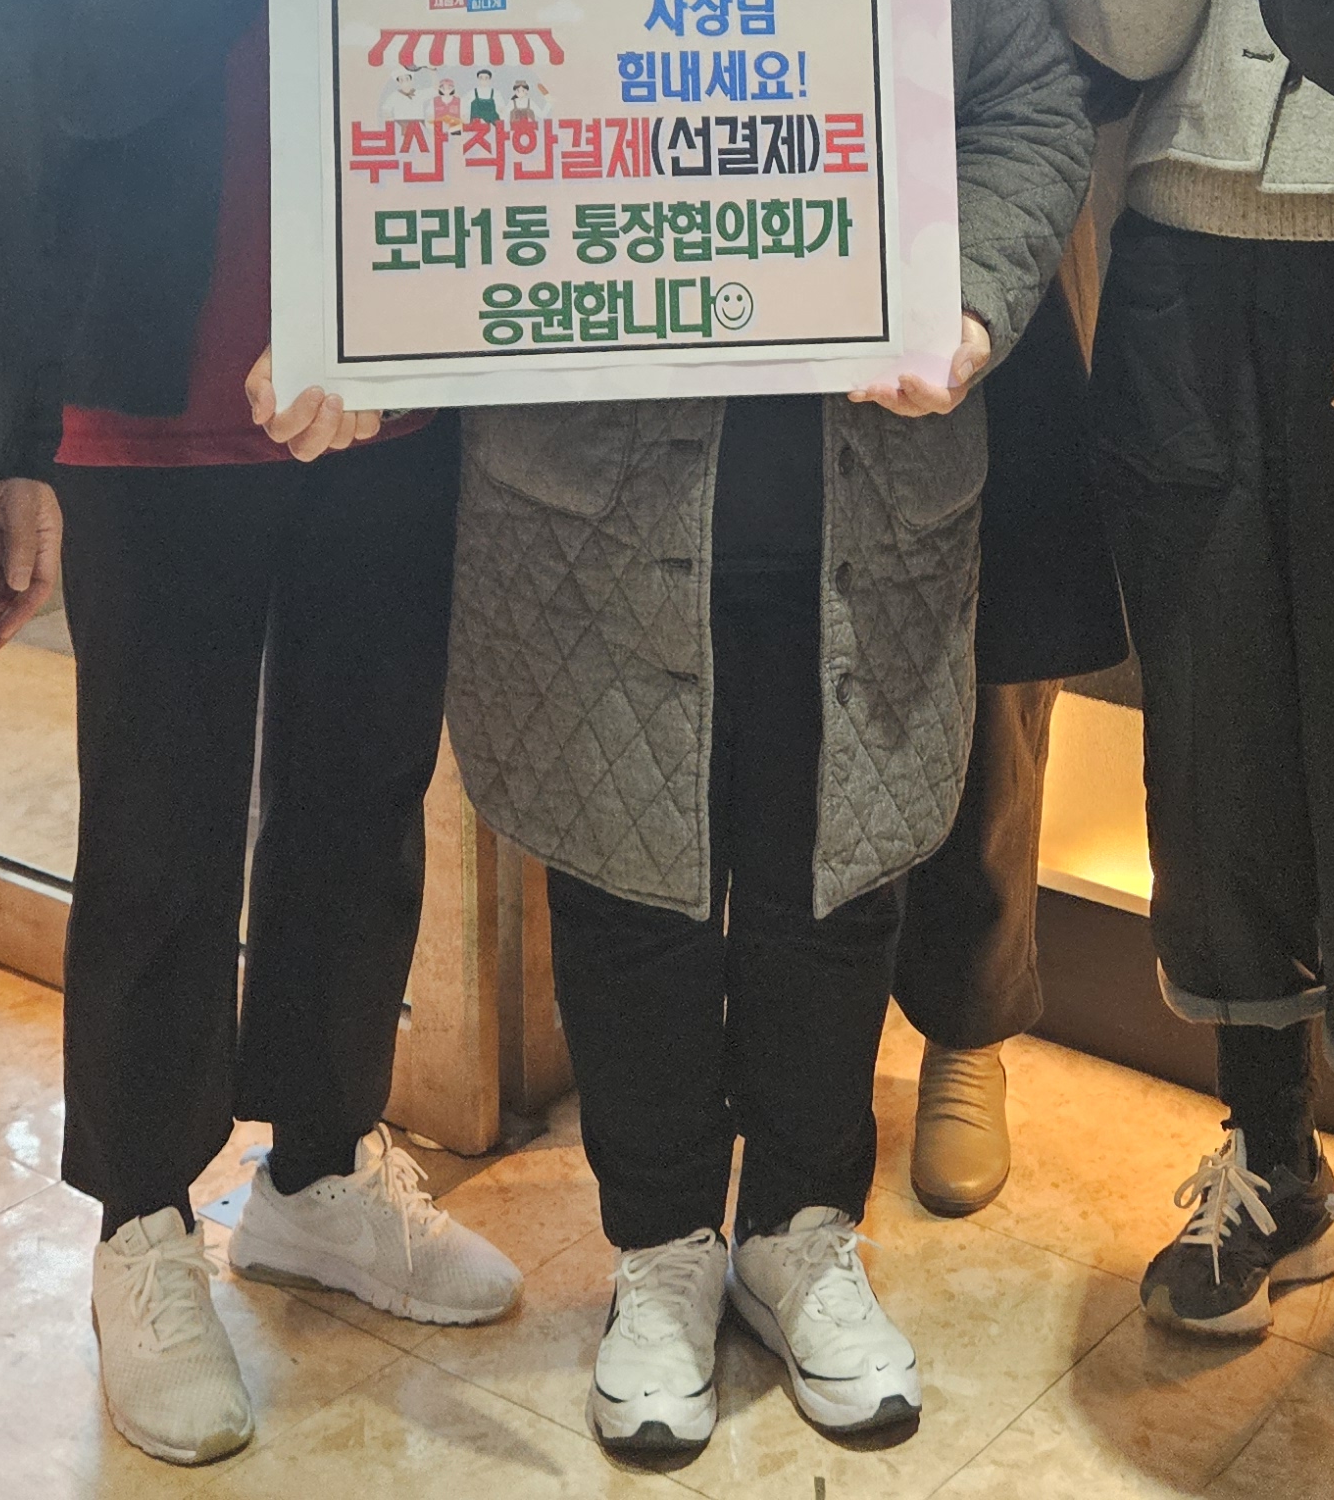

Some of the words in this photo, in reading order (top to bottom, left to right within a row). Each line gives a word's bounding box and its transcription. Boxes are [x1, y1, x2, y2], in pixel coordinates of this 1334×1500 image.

[616, 51, 808, 103] 힘내세요!
[349, 116, 448, 184] 부산
[371, 206, 550, 271] 모라1동
[572, 197, 853, 264] 통장협의회가
[479, 277, 712, 344] 응원합니다
